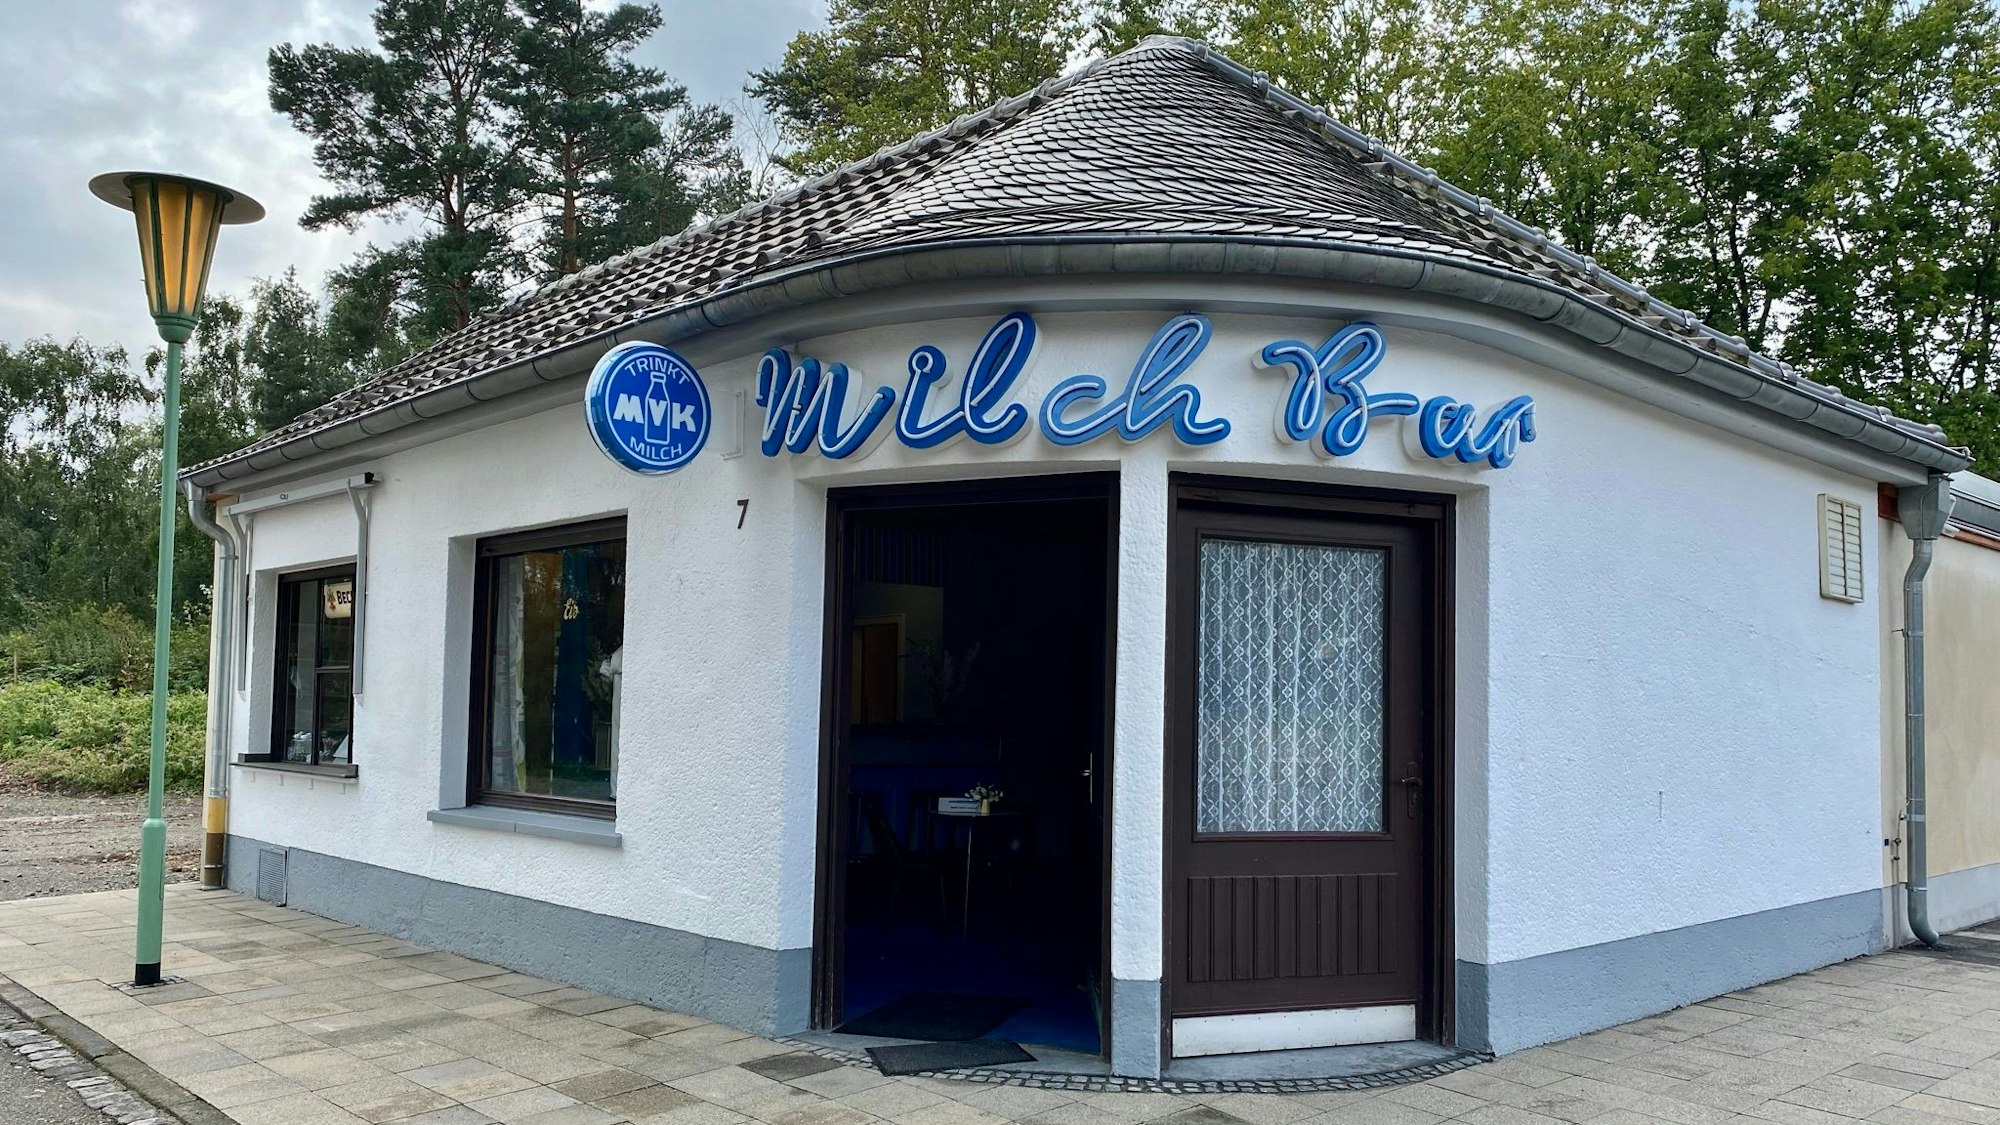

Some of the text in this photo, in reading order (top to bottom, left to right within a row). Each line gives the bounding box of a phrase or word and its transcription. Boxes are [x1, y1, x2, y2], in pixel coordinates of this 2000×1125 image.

[624, 356, 690, 385] TRINKT
[756, 311, 1536, 470] Milch Bar
[612, 392, 697, 433] MVK
[629, 436, 683, 460] MILCH
[737, 498, 750, 530] 7
[336, 590, 352, 605] BEC
